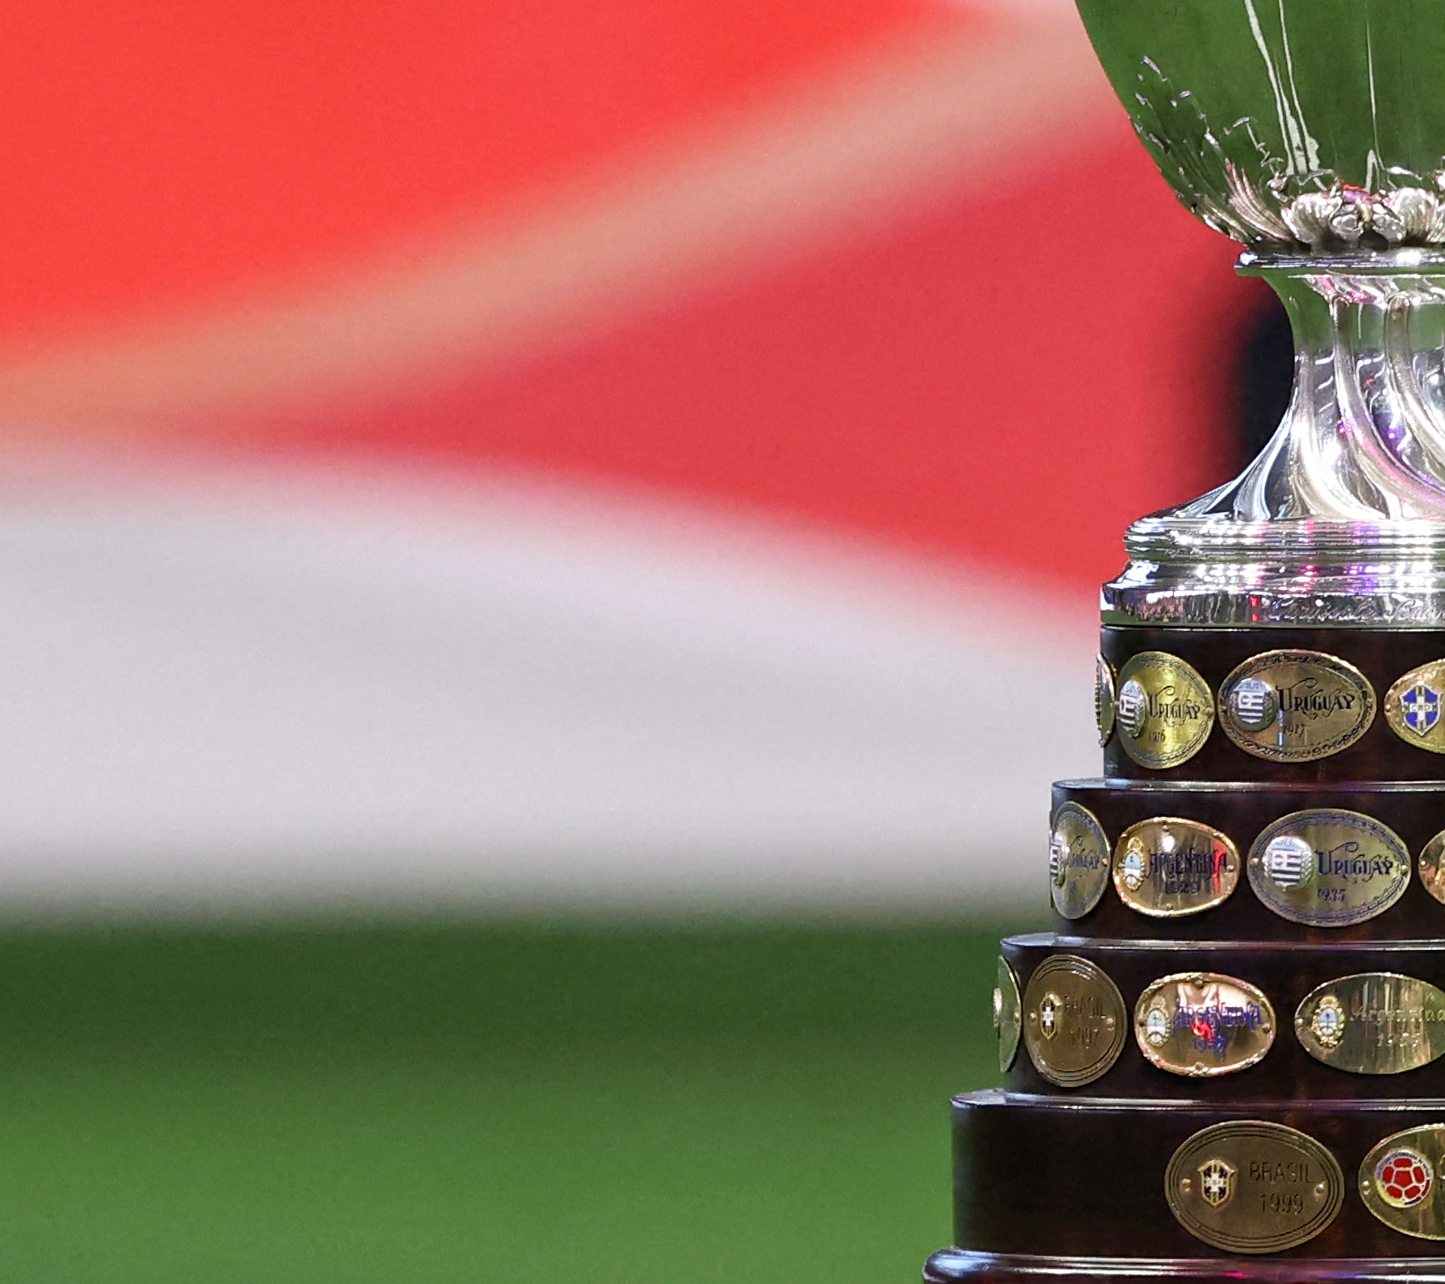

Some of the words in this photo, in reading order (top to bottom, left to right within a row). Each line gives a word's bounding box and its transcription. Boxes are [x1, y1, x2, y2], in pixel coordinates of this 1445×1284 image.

[1276, 677, 1355, 720] URUGUAY
[1315, 841, 1394, 884] URUGUAY
[1249, 1161, 1316, 1185] BRASIL
[1259, 1191, 1305, 1215] 1999
